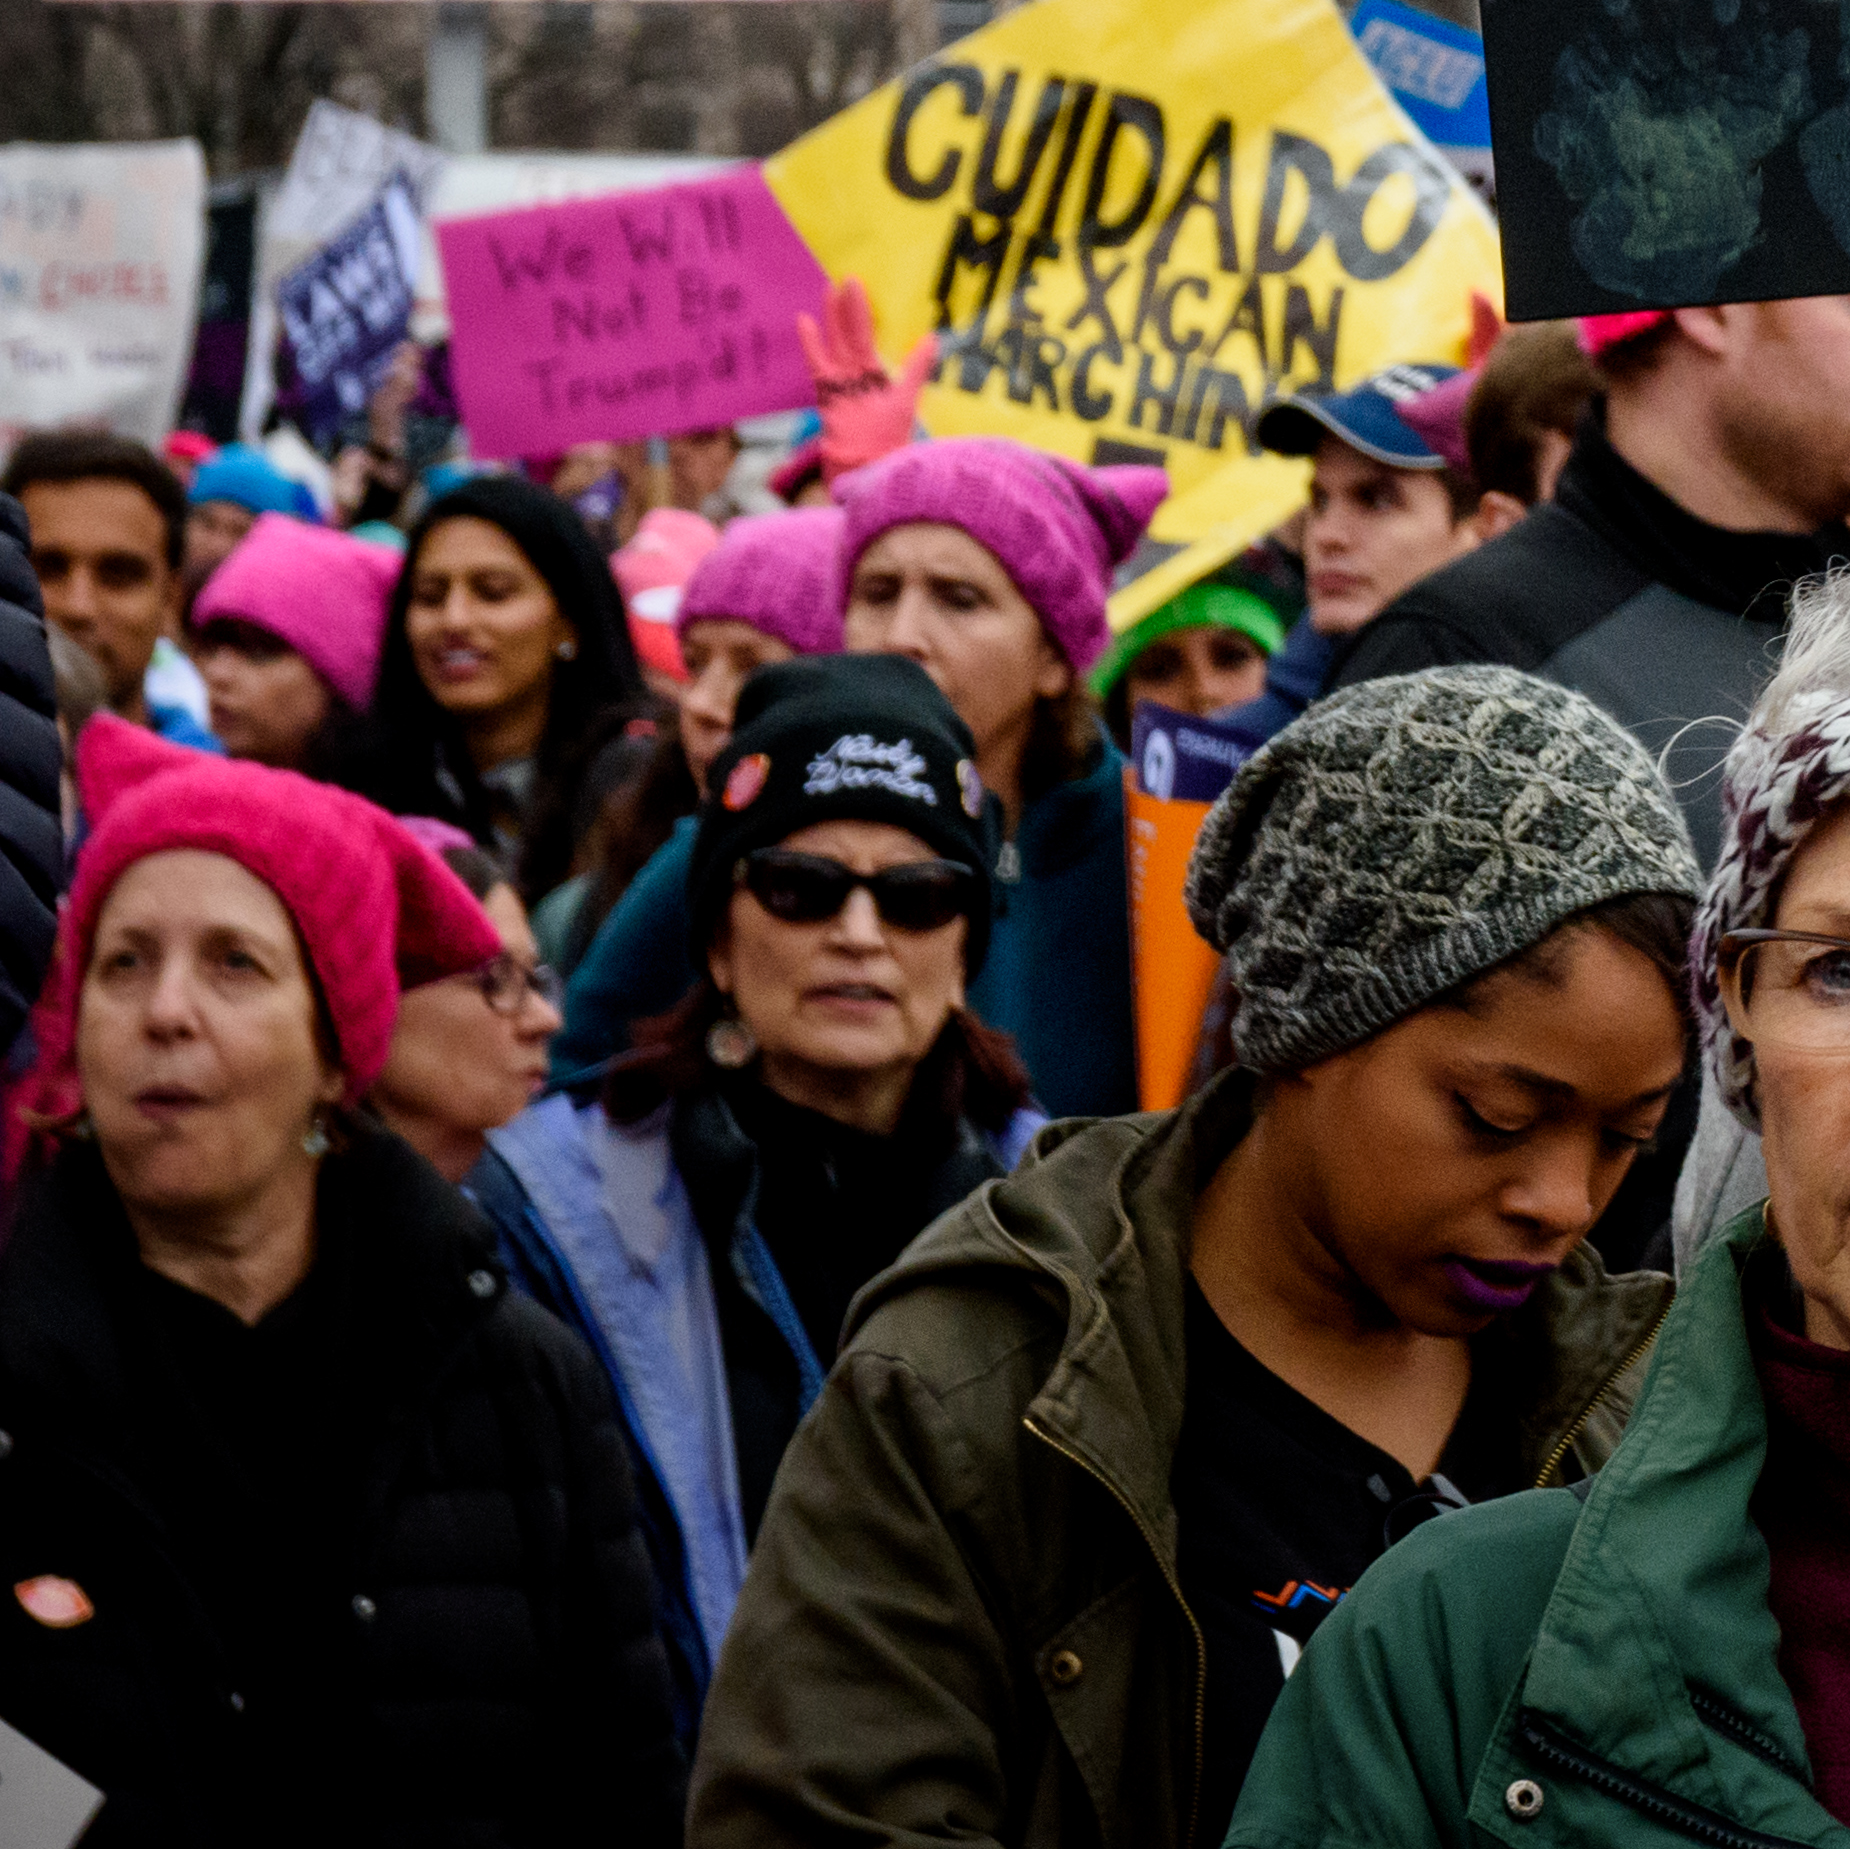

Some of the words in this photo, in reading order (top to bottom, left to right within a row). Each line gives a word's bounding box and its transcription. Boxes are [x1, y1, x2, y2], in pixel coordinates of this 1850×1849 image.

[884, 63, 1453, 280] CUIDADO
[488, 226, 594, 291] We
[615, 195, 742, 267] Will
[552, 282, 646, 344] Not
[678, 268, 745, 325] Be
[934, 214, 1345, 395] MEXICAN
